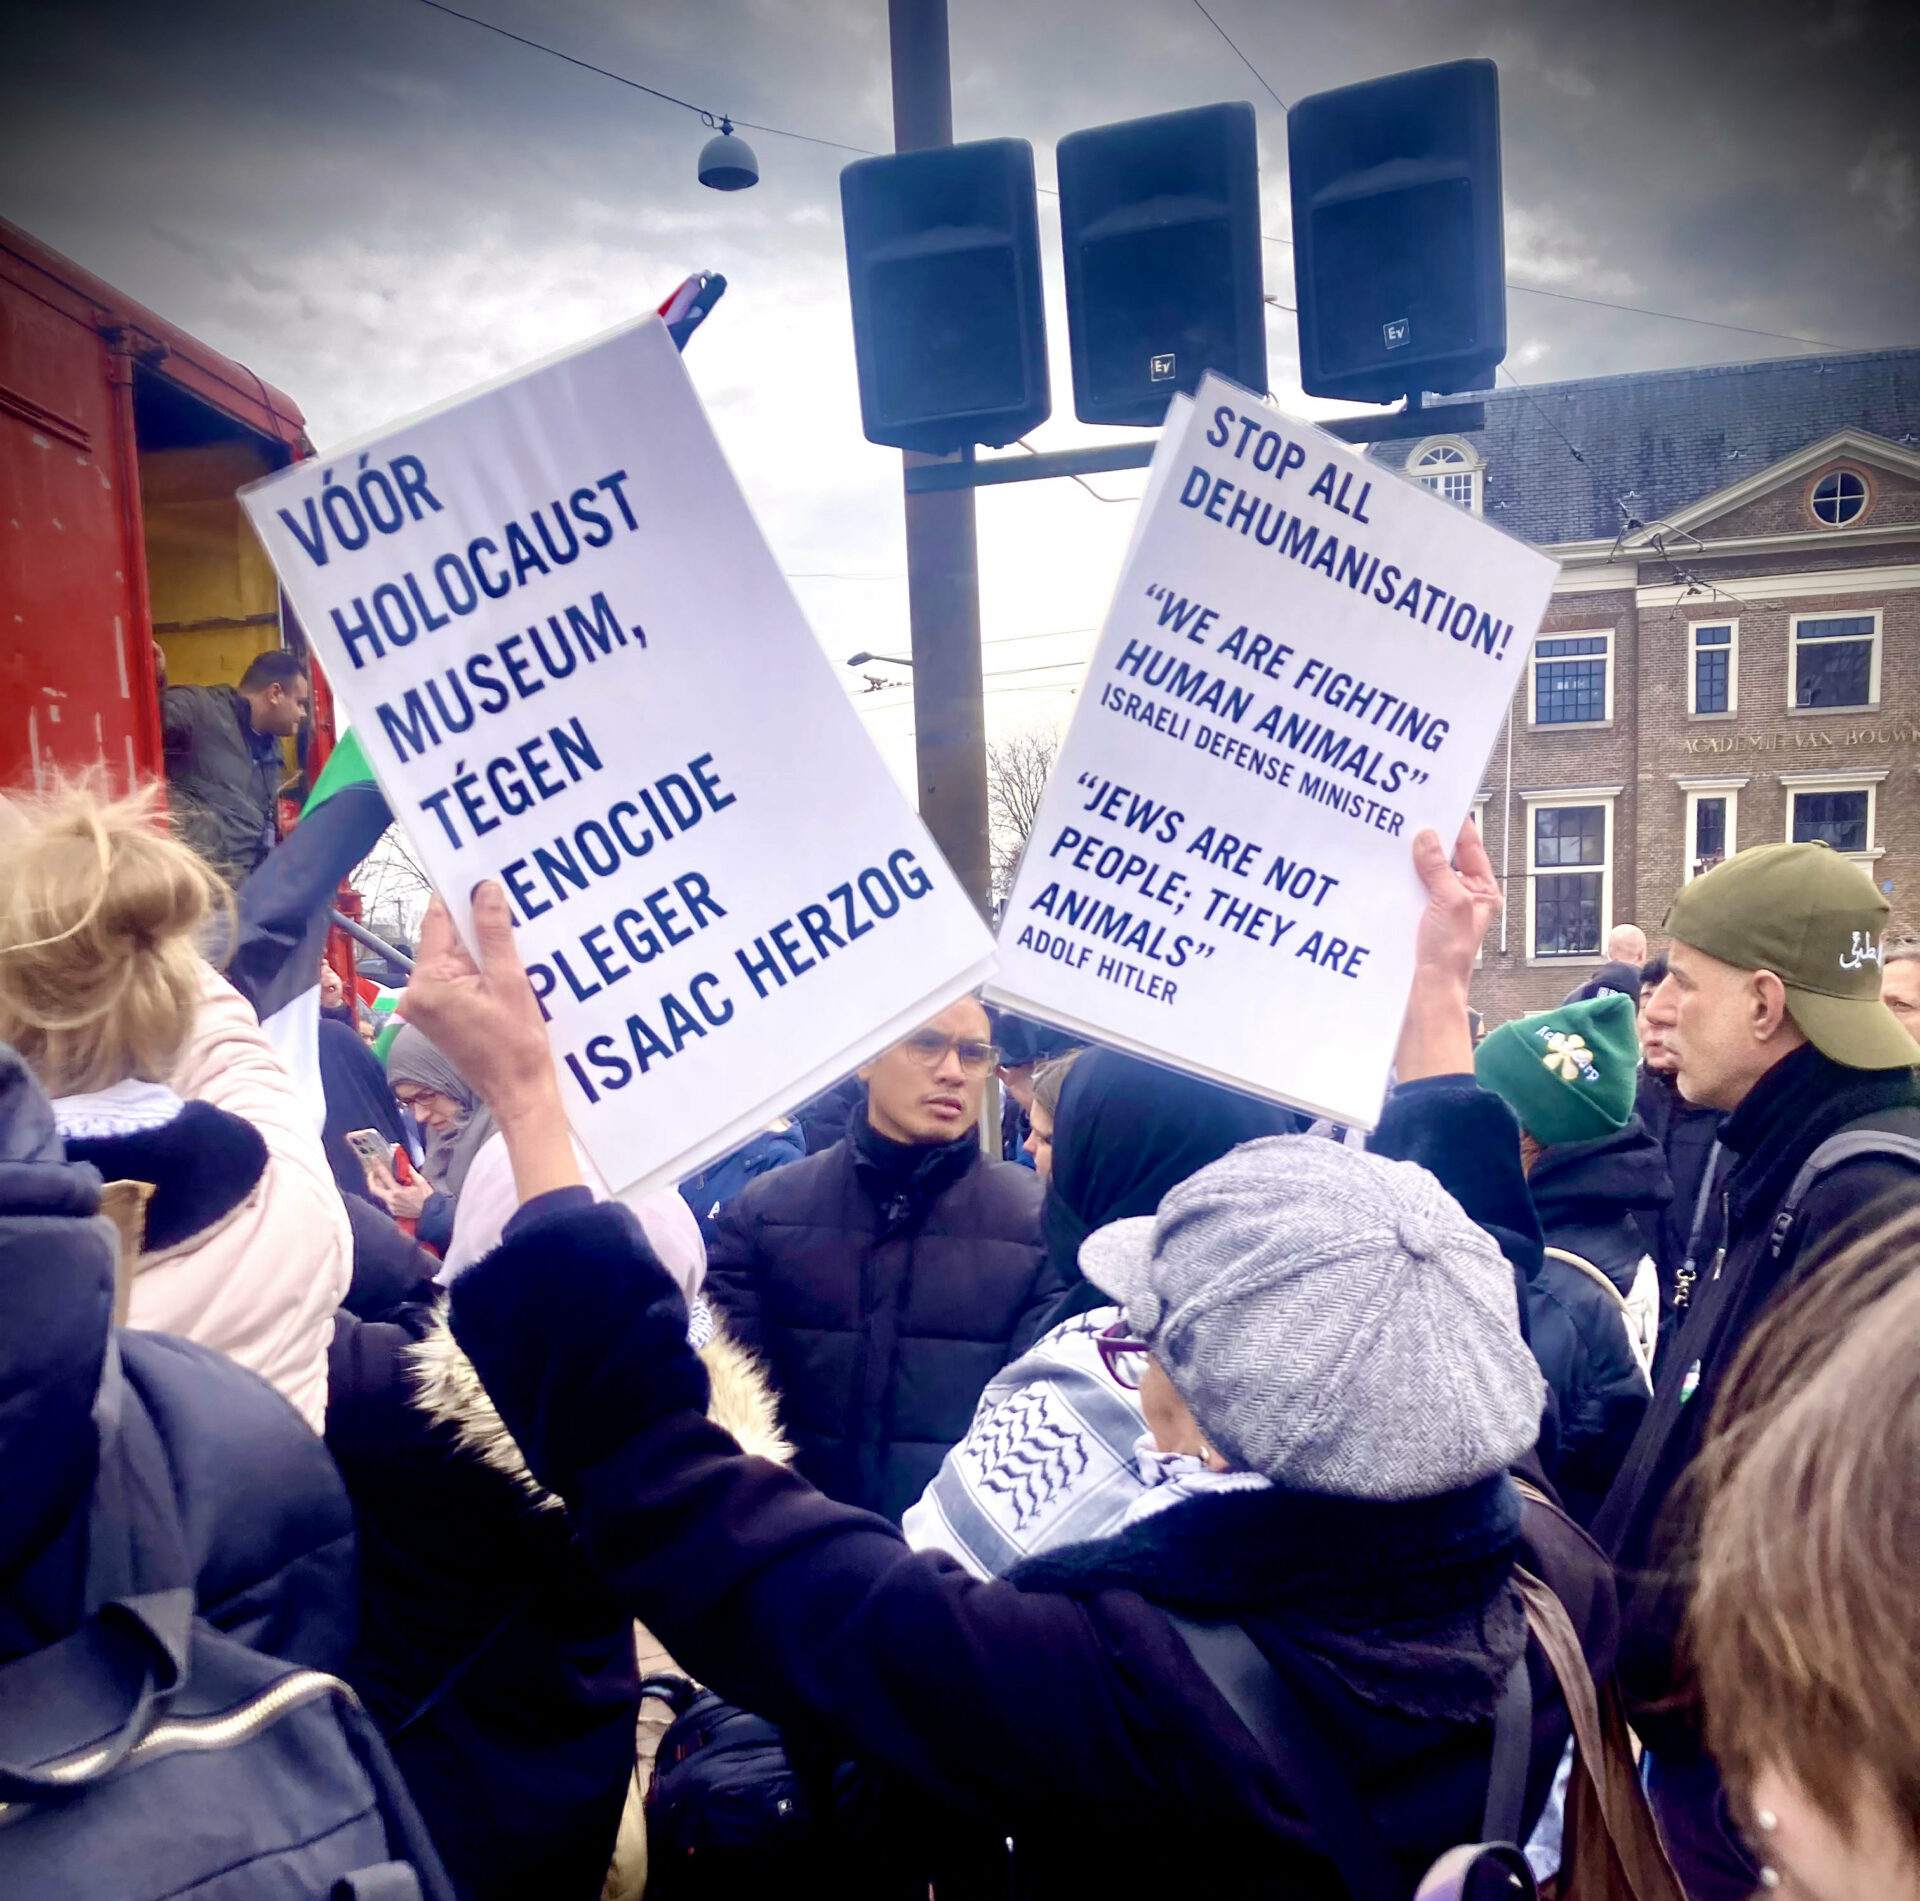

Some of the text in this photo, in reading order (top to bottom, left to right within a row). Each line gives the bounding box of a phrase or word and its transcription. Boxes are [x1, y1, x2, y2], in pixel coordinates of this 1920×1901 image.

[277, 452, 445, 568] VÓÓR
[1206, 405, 1372, 525] STOP ALL
[329, 469, 640, 670] HOLOCAUST
[1179, 465, 1514, 661] DEHUMANISATION!
[375, 591, 648, 764] MUSEUM,
[1115, 638, 1255, 724] HUMAN
[1216, 625, 1295, 680] ARE
[1293, 658, 1450, 753] FIGHTING
[1795, 732, 1832, 747] VAN
[419, 716, 604, 850] TÉGEN
[1101, 682, 1405, 837] ISRAELI DEFENSE MINISTER
[501, 752, 737, 928] ENOCIDE
[1051, 826, 1370, 979] PEOPLE; THEY ARE
[1185, 825, 1263, 878] ARE
[1262, 855, 1339, 907] NOT
[525, 871, 728, 1022] PLEGER
[564, 848, 934, 1105] ISAAC HERZOG
[1017, 925, 1178, 1005] ADOLF HITLER
